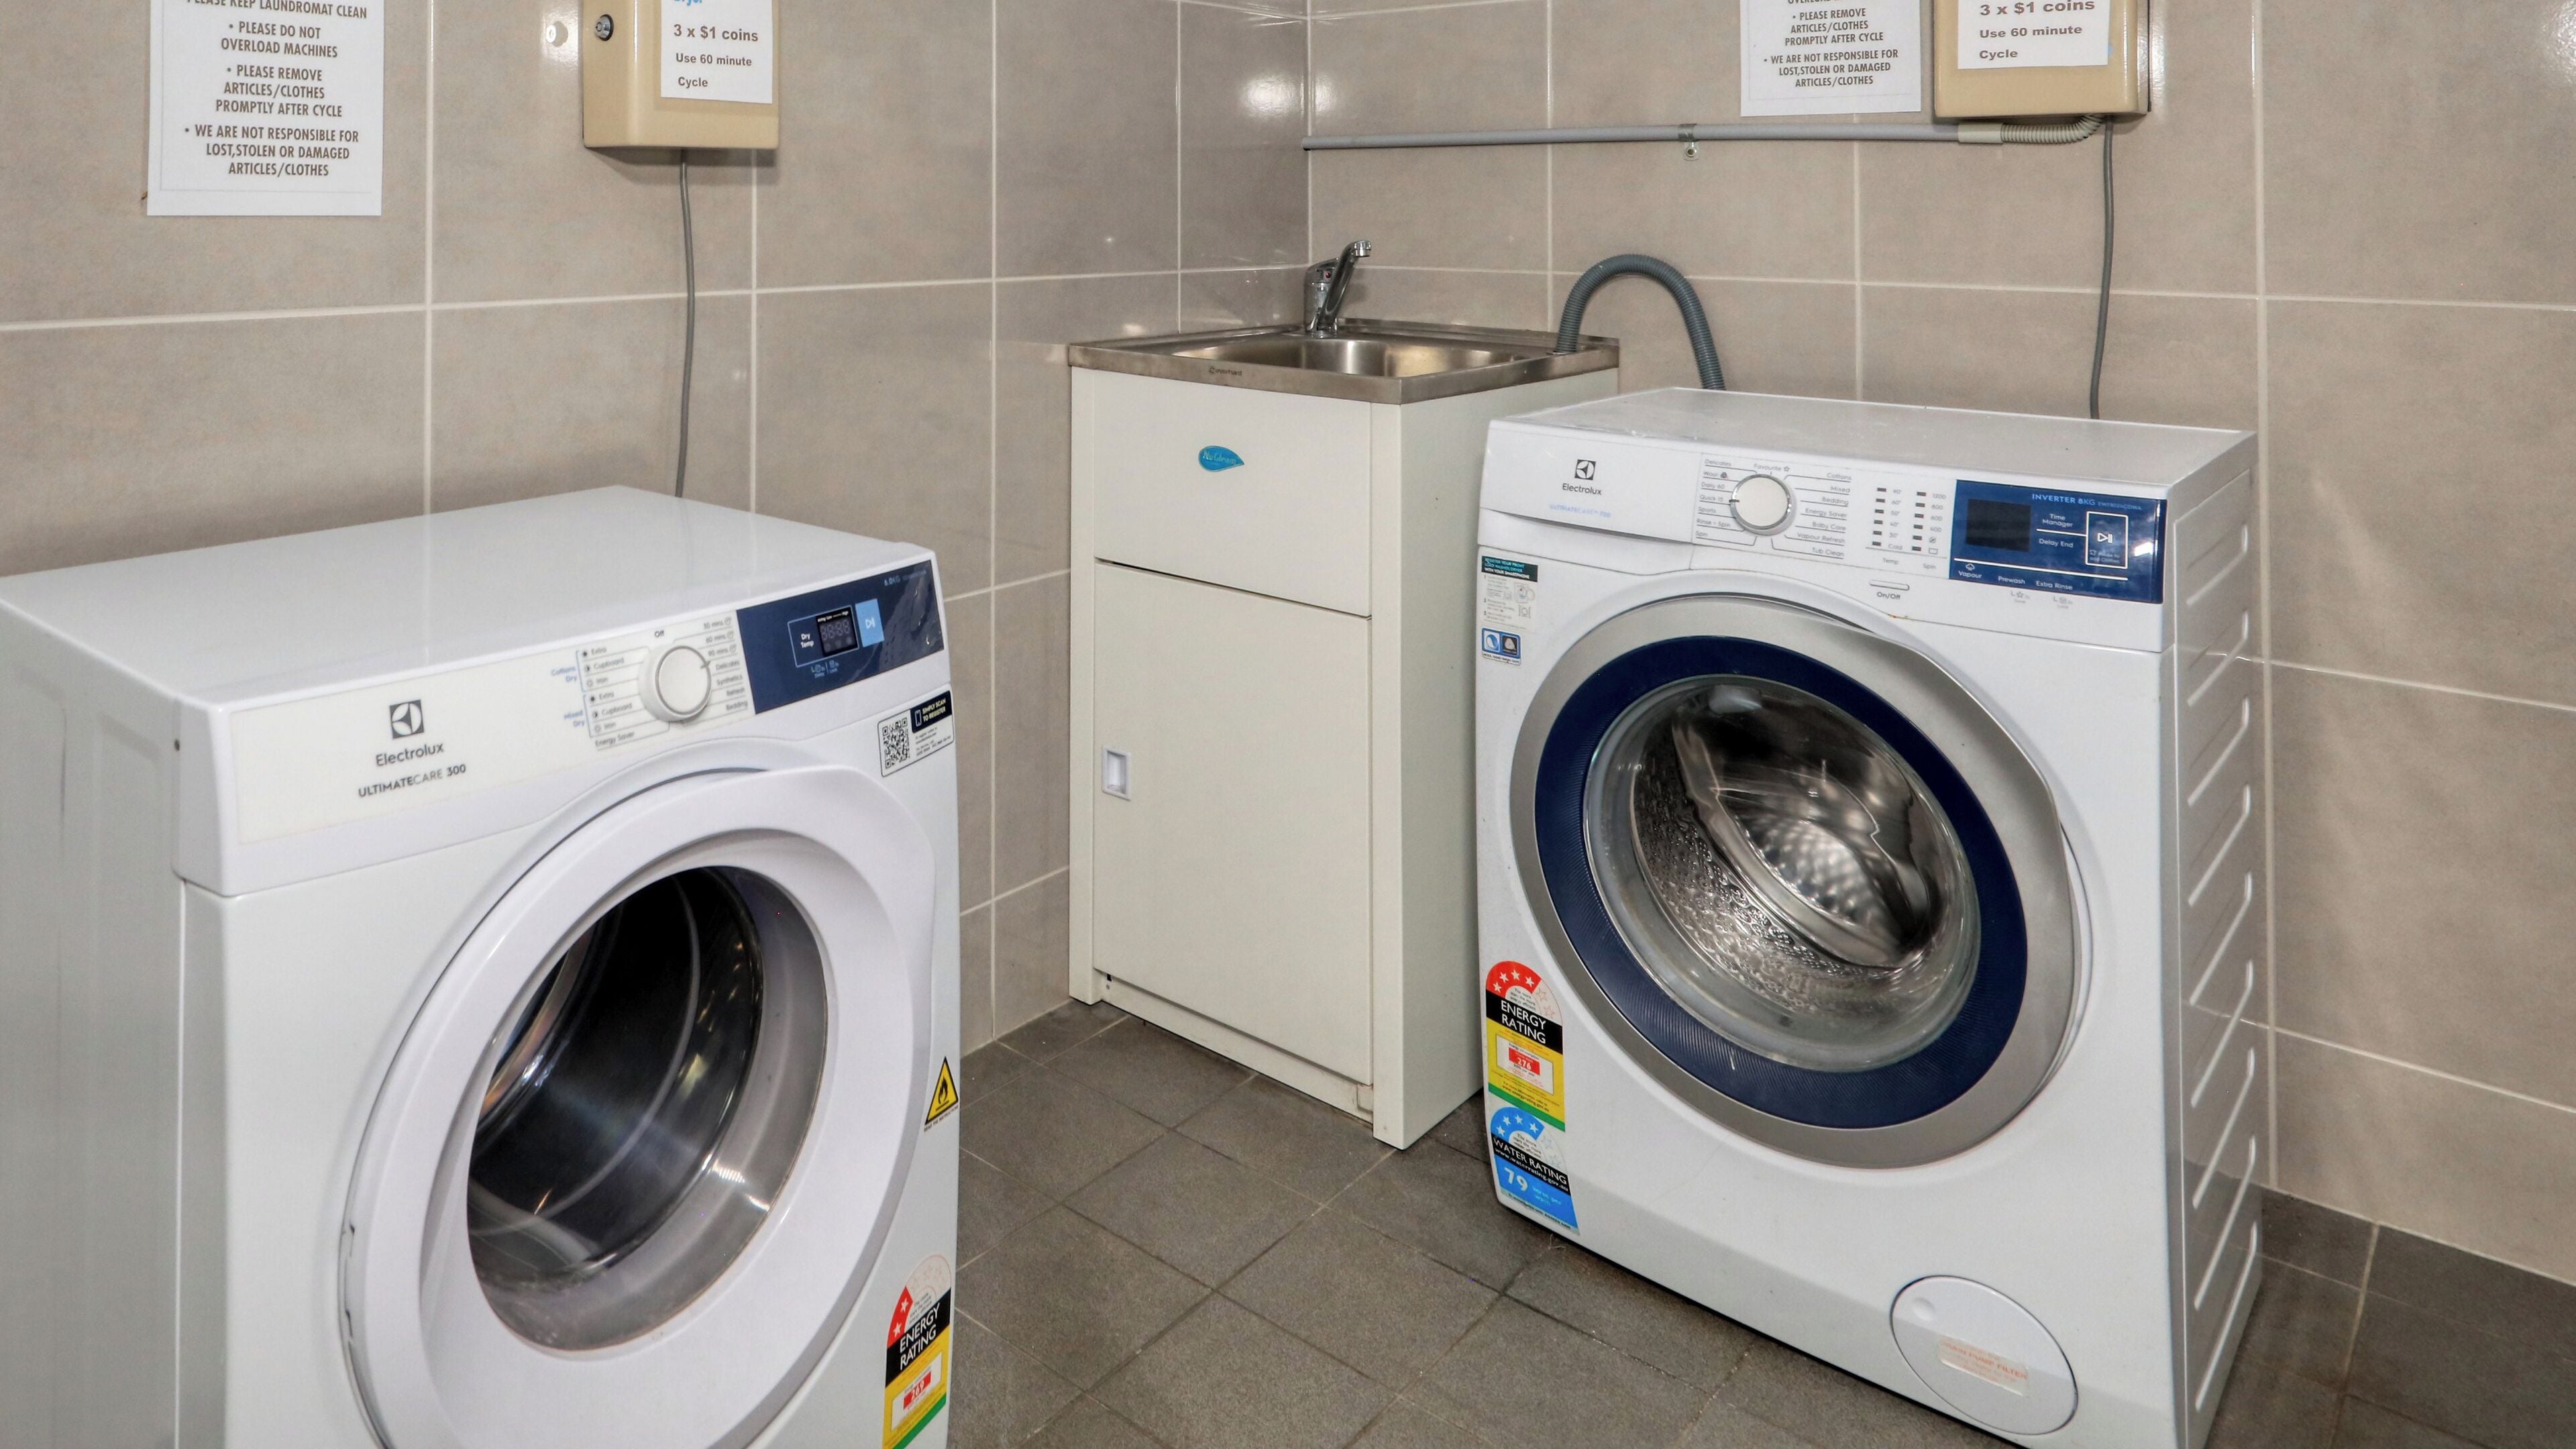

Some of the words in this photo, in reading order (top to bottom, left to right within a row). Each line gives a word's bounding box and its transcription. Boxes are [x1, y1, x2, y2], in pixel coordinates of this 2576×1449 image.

[260, 0, 333, 15] LAUNDROMAT
[337, 5, 366, 19] CLEAN
[1800, 11, 1827, 20] PLEASE
[1831, 8, 1866, 18] REMOVE
[1980, 5, 1990, 15] 3
[1997, 6, 2006, 14] x
[2015, 2, 2035, 15] $1
[2043, 0, 2095, 12] coins
[239, 21, 276, 36] PLEASE
[280, 25, 295, 36] DO
[299, 27, 321, 39] NOT
[674, 24, 682, 36] 3
[687, 29, 694, 38] x
[700, 26, 716, 40] $1
[722, 29, 758, 42] coins
[1791, 21, 1868, 34] ARTICLES/CLOTHES
[1980, 30, 2006, 38] Use
[2011, 28, 2027, 37] 60
[2033, 26, 2082, 36] minute
[1785, 36, 1827, 46] PROMPTLY
[1831, 34, 1856, 44] AFTER
[1859, 32, 1883, 42] CYCLE
[221, 38, 280, 54] OVERLOAD
[284, 43, 337, 58] MACHINES
[676, 53, 696, 63] Use
[700, 54, 712, 64] 60
[716, 55, 751, 66] minute
[1771, 55, 1783, 64] WE
[1786, 54, 1801, 62] ARE
[1805, 54, 1820, 62] NOT
[1824, 50, 1878, 61] RESPONSIBLE
[1882, 50, 1898, 58] FOR
[1980, 50, 2018, 60] Cycle
[237, 65, 274, 78] PLEASE
[278, 68, 322, 81] REMOVE
[1779, 66, 1830, 75] LOST,STOLEN
[1833, 64, 1845, 73] OR
[1848, 62, 1890, 72] DAMAGED
[678, 77, 708, 89] Cycle
[1795, 76, 1873, 87] ARTICLES/CLOTHES
[224, 82, 325, 99] ARTICLES/CLOTHES
[216, 100, 274, 115] PROMPTLY
[278, 104, 308, 115] AFTER
[313, 105, 341, 117] CYCLE
[195, 125, 215, 138] WE
[217, 126, 237, 138] ARE
[241, 127, 264, 140] NOT
[268, 127, 335, 142] RESPONSIBLE
[339, 130, 358, 142] FOR
[207, 144, 276, 158] LOST,STOLEN
[280, 146, 294, 158] OR
[299, 146, 350, 159] DAMAGED
[229, 163, 329, 176] ARTICLES/CLOTHES
[1754, 464, 1782, 472] Favourite
[1562, 483, 1602, 495] Electrolux
[1701, 482, 1715, 490] Daily
[1822, 497, 1848, 506] Bedding
[2032, 494, 2076, 503] INVERTER
[1805, 508, 1827, 517] Energy
[1813, 522, 1828, 530] Baby
[2043, 519, 2073, 527] Manager
[1797, 533, 1820, 541] Vapour
[2039, 539, 2058, 547] Delay
[1958, 571, 1982, 579] Vapour
[1998, 576, 2025, 584] Prewash
[1877, 592, 1900, 600] On/Off
[376, 743, 444, 767] Electrolux
[358, 769, 443, 798] ULTIMATECARE
[447, 764, 466, 776] 300
[1501, 1000, 1546, 1030] ENERGY
[1502, 1014, 1546, 1044] RATING
[1517, 1057, 1532, 1070] 276
[1493, 1138, 1527, 1164] WATER
[1529, 1159, 1566, 1185] RATING
[1505, 1167, 1528, 1191] 79
[900, 1302, 941, 1353] ENERGY
[900, 1326, 936, 1371] RATING
[1997, 1363, 2028, 1378] FILTER
[911, 1381, 925, 1401] 269
